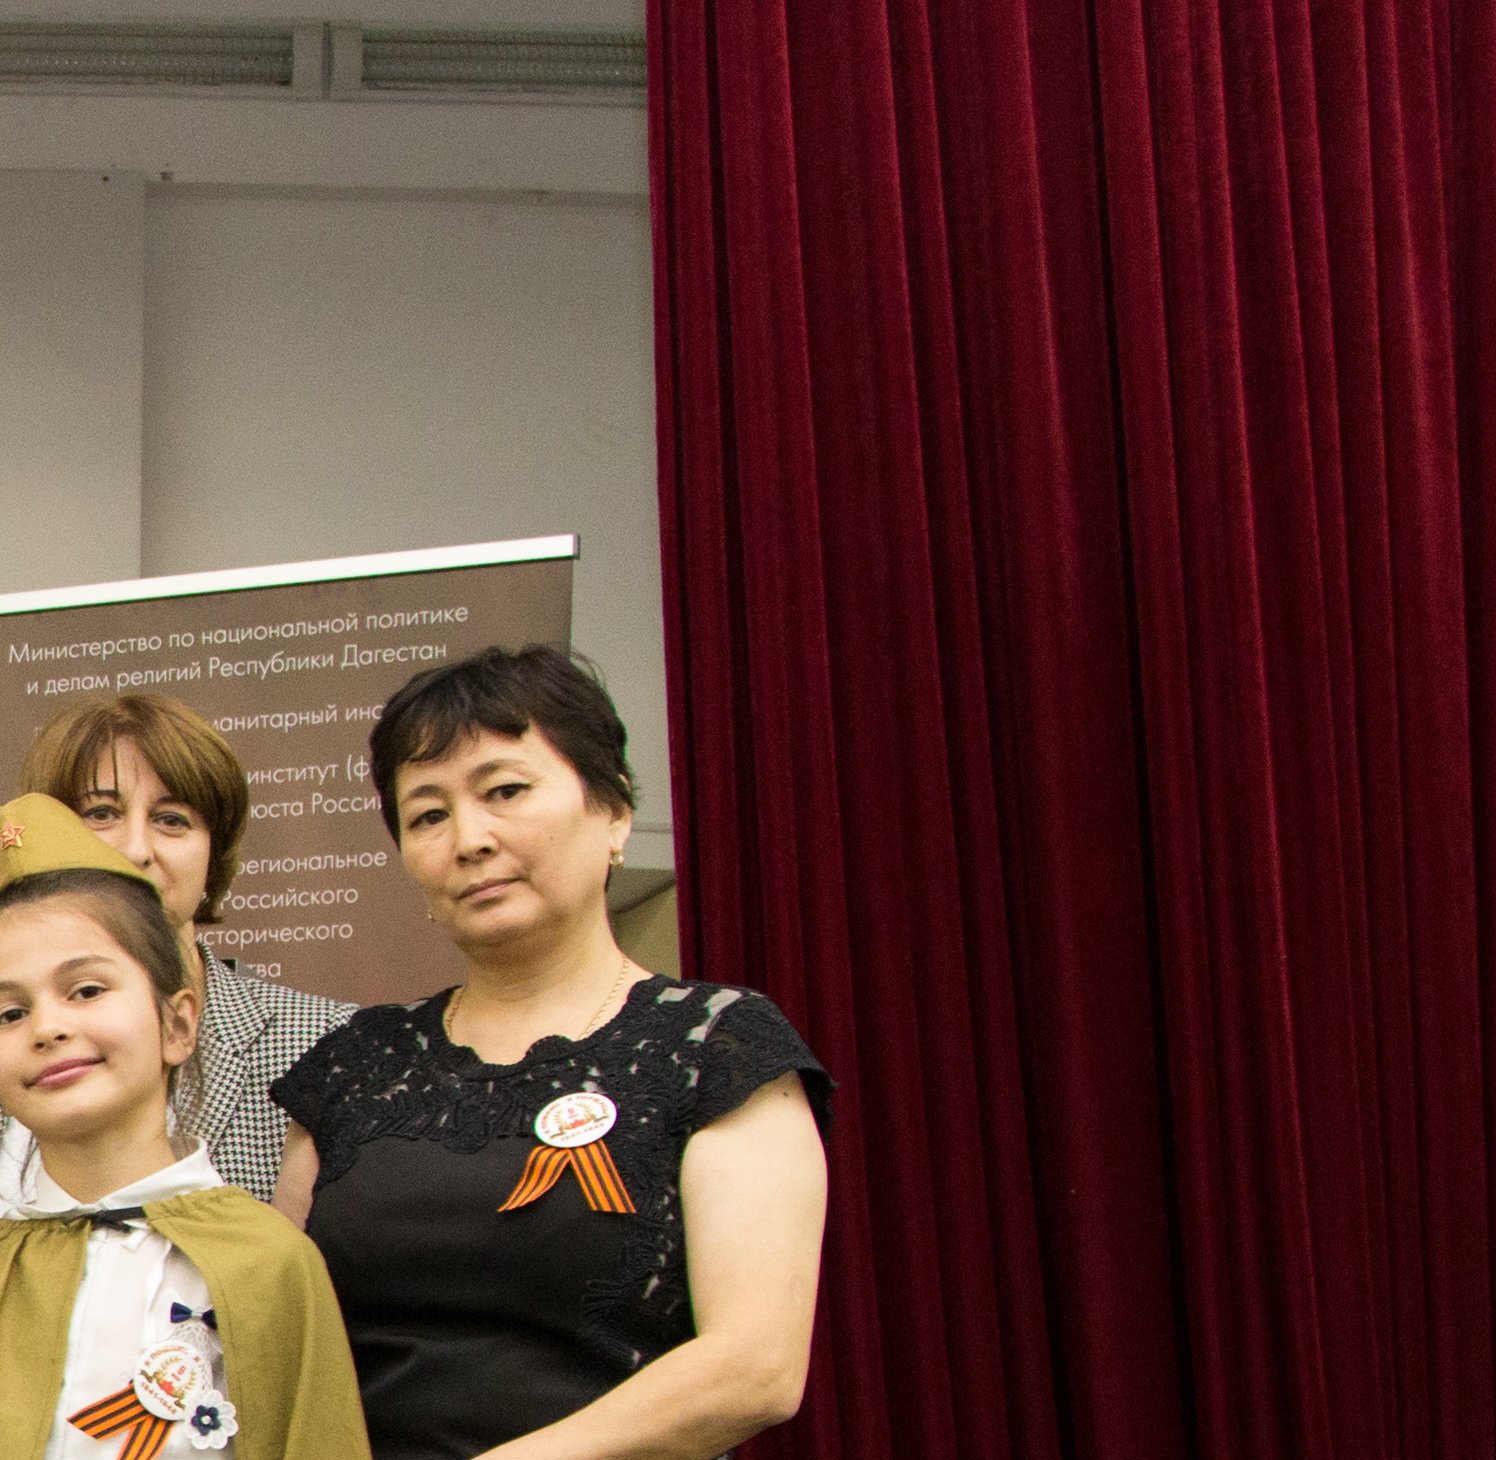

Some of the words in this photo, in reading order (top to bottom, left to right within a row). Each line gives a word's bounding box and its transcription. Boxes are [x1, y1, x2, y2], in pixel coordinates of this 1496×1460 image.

[9, 635, 162, 664] Министерство
[169, 632, 195, 648] по
[202, 613, 358, 645] национальной
[366, 606, 469, 630] политике
[27, 681, 38, 695] и
[45, 674, 110, 696] делам
[116, 662, 201, 691] религий
[209, 651, 334, 680] Республики
[341, 644, 447, 670] Дагестан
[211, 704, 338, 733] манитарный
[247, 764, 339, 785] институт
[251, 801, 304, 819] юста
[312, 793, 382, 814] Росси
[220, 888, 358, 910] Российского
